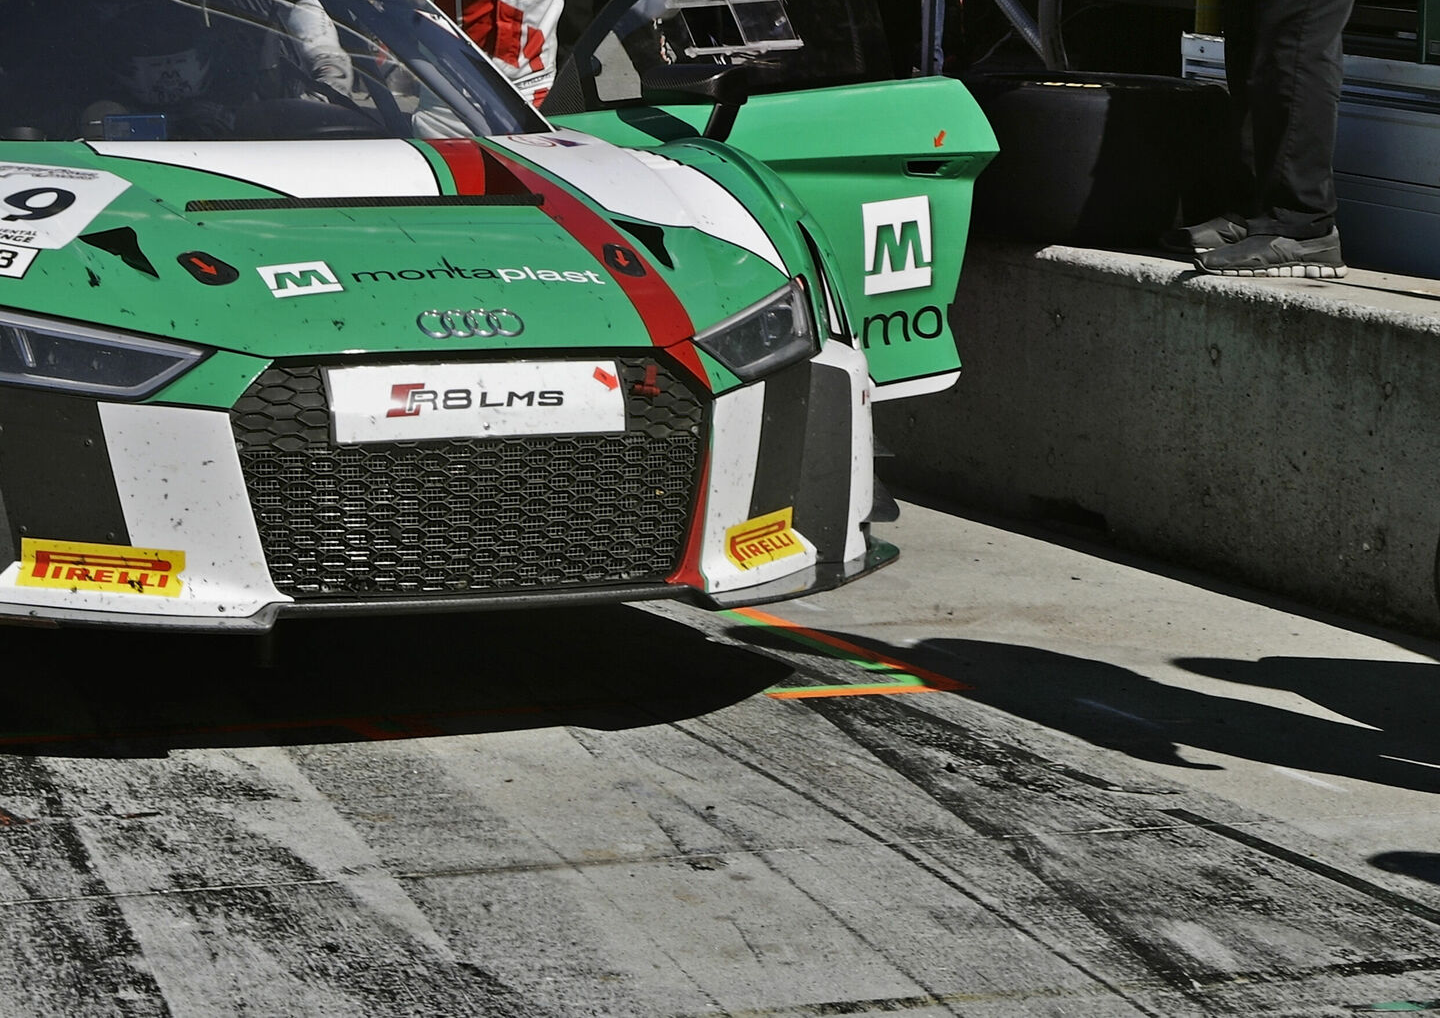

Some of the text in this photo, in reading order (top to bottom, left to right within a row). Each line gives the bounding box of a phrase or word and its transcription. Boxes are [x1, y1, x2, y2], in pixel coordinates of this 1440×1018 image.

[351, 264, 606, 285] montaplast
[862, 304, 944, 349] mo
[479, 390, 565, 408] LMS
[730, 519, 795, 563] PIRELLI
[32, 549, 173, 590] PIRELLI
